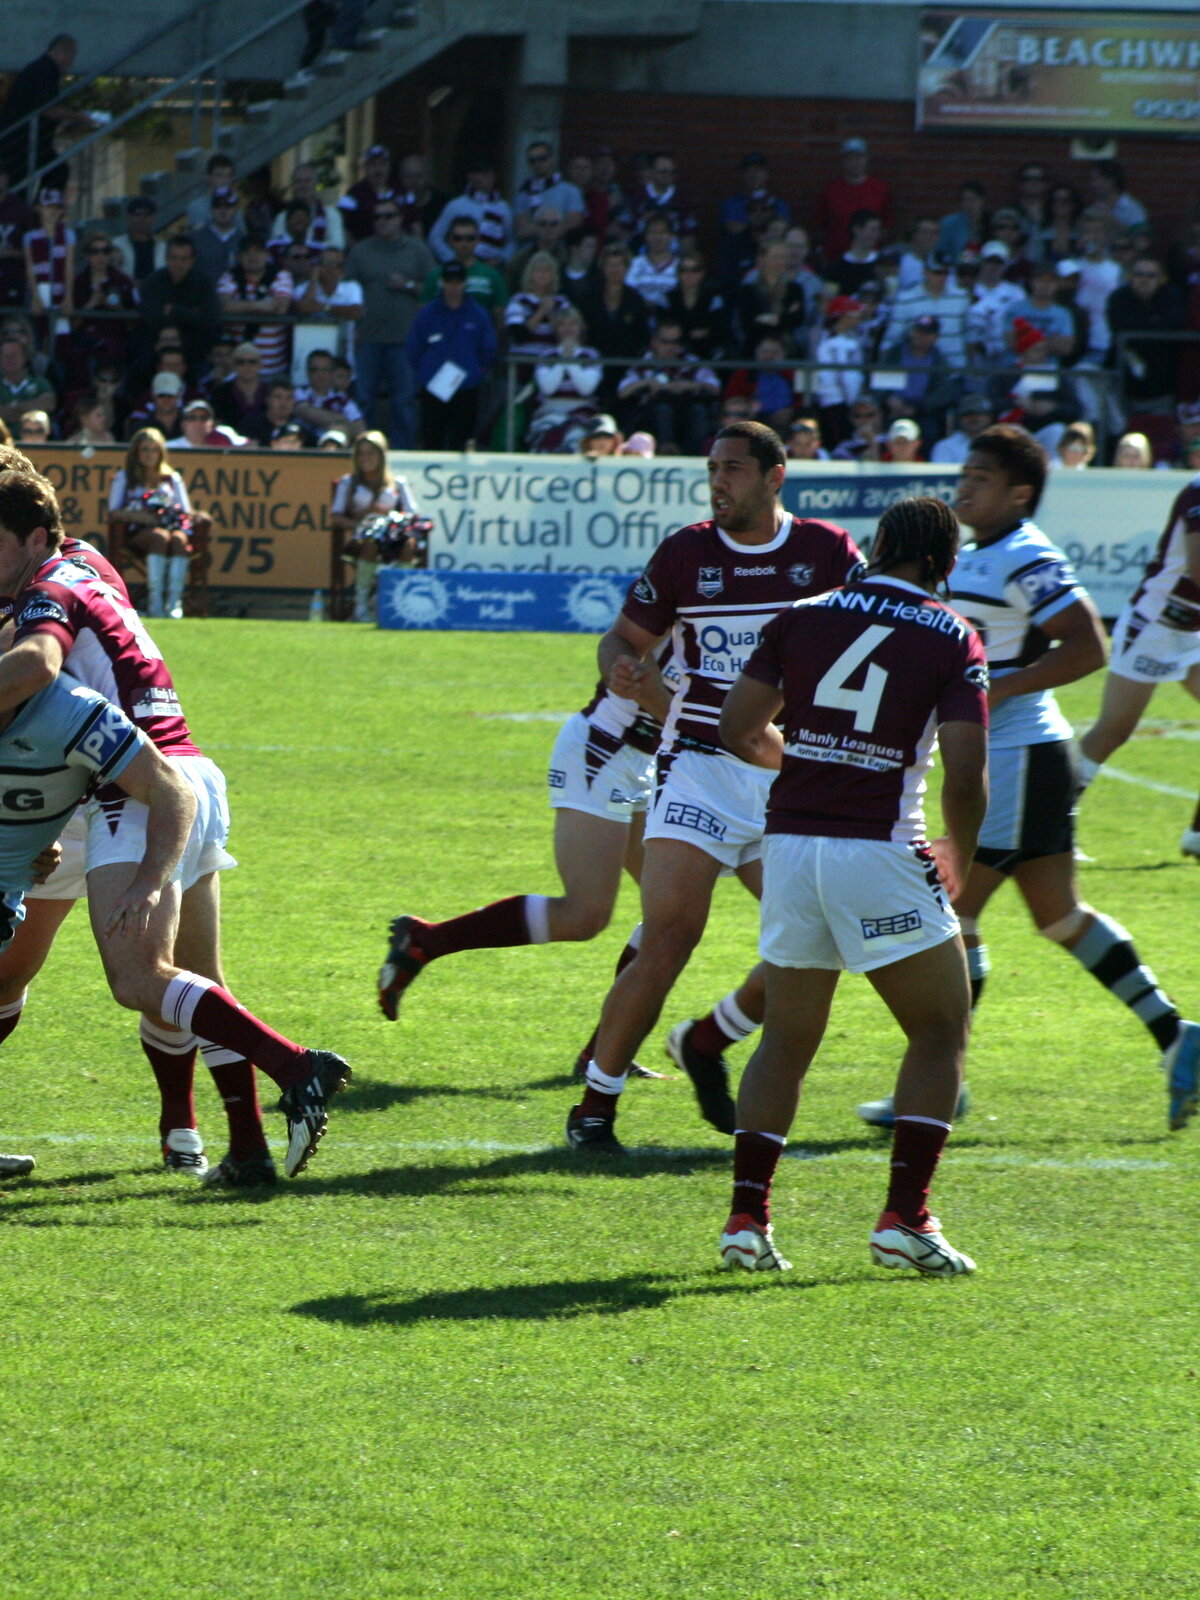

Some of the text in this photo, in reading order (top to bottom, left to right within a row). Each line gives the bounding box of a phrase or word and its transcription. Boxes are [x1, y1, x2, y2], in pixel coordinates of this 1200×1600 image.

[422, 464, 598, 504] Serviced
[800, 487, 858, 510] now
[438, 508, 572, 548] Virtual
[733, 565, 777, 577] Reebok
[877, 598, 966, 640] Health
[703, 655, 725, 672] Eco
[813, 624, 895, 733] 4
[799, 728, 905, 759] Manly Leagues
[664, 802, 727, 841] REED
[861, 909, 922, 939] REED
